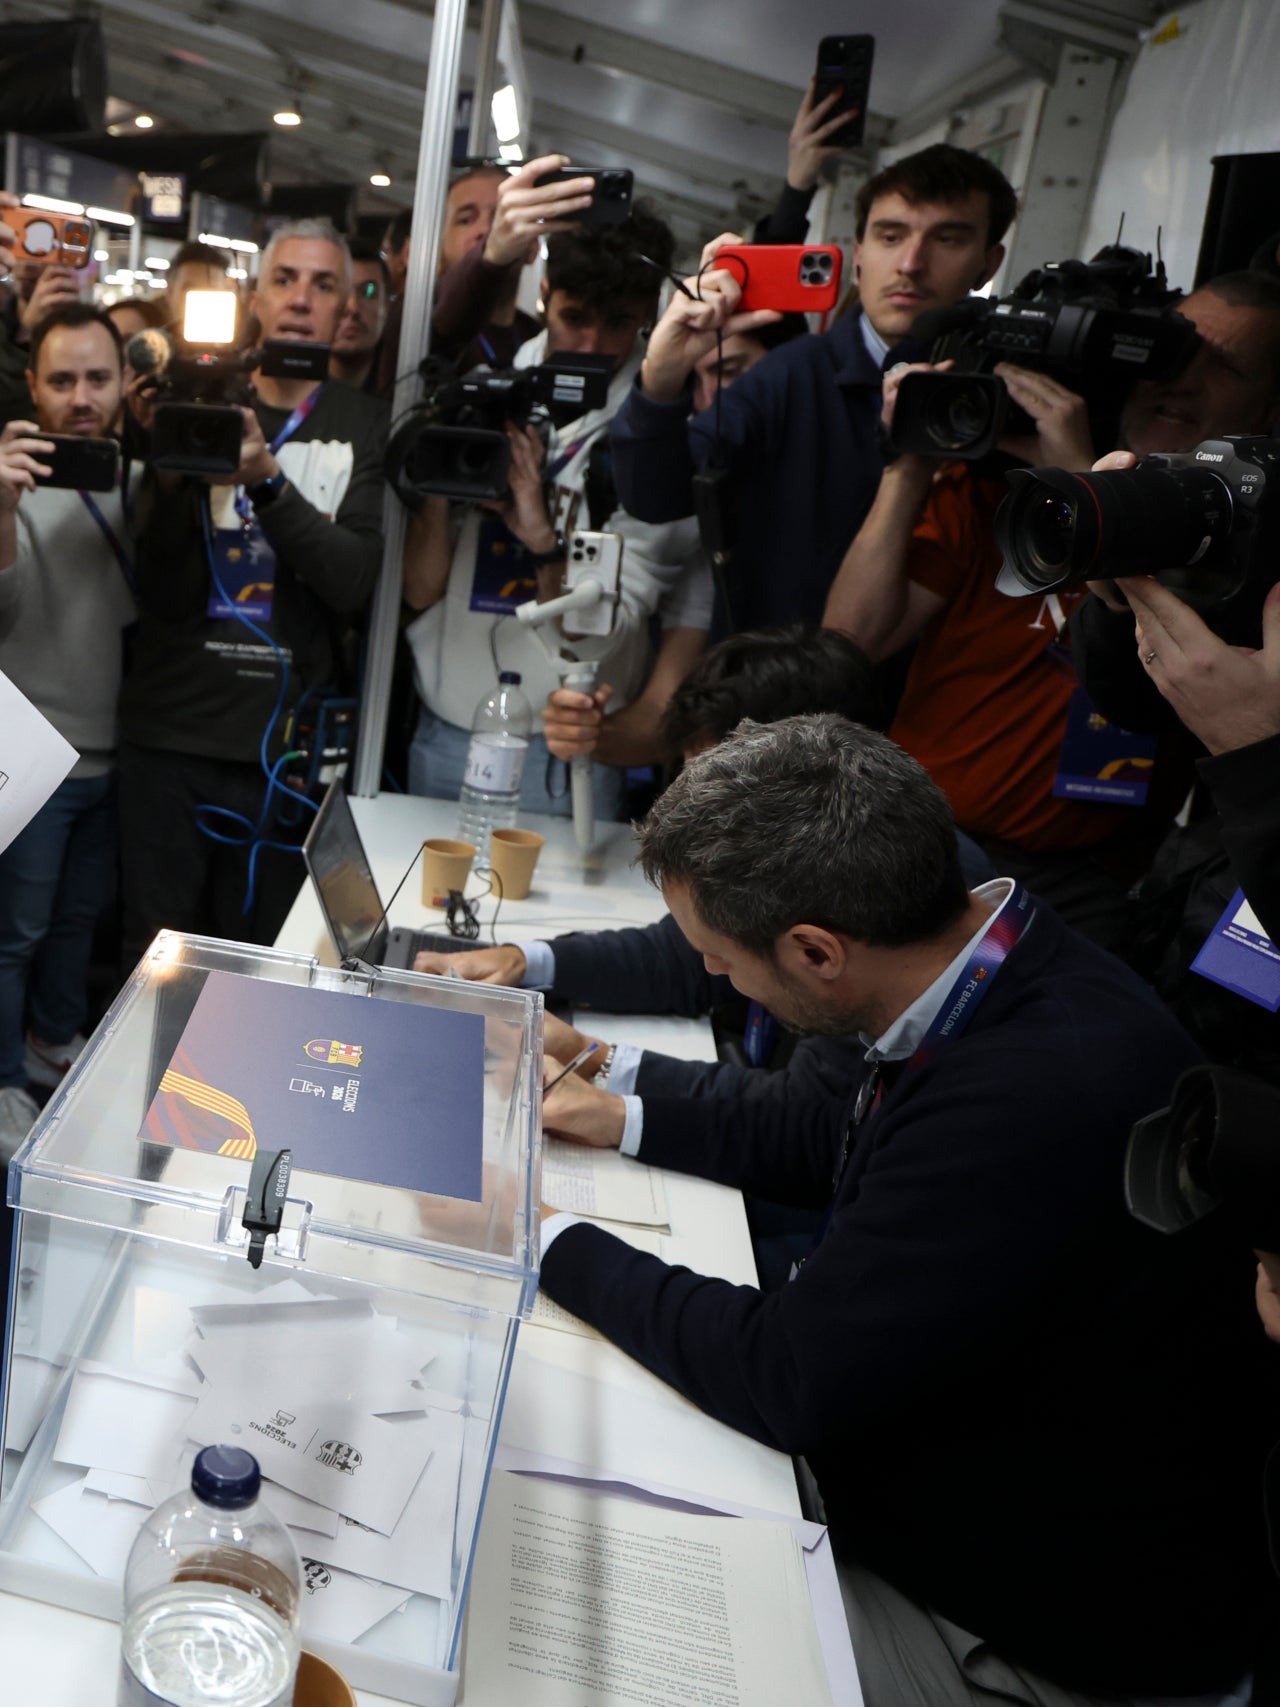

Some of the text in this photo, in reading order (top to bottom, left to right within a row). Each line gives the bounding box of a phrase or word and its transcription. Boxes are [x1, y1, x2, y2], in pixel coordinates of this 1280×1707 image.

[1195, 451, 1224, 463] Canon
[1241, 474, 1259, 482] EOS
[1240, 485, 1254, 494] R3
[938, 980, 978, 1036] FC BARCELONA
[342, 1079, 360, 1113] ELECCIONS
[274, 1154, 290, 1198] PL0038309
[248, 1420, 297, 1449] ELECCIONS
[265, 1424, 287, 1438] 2026
